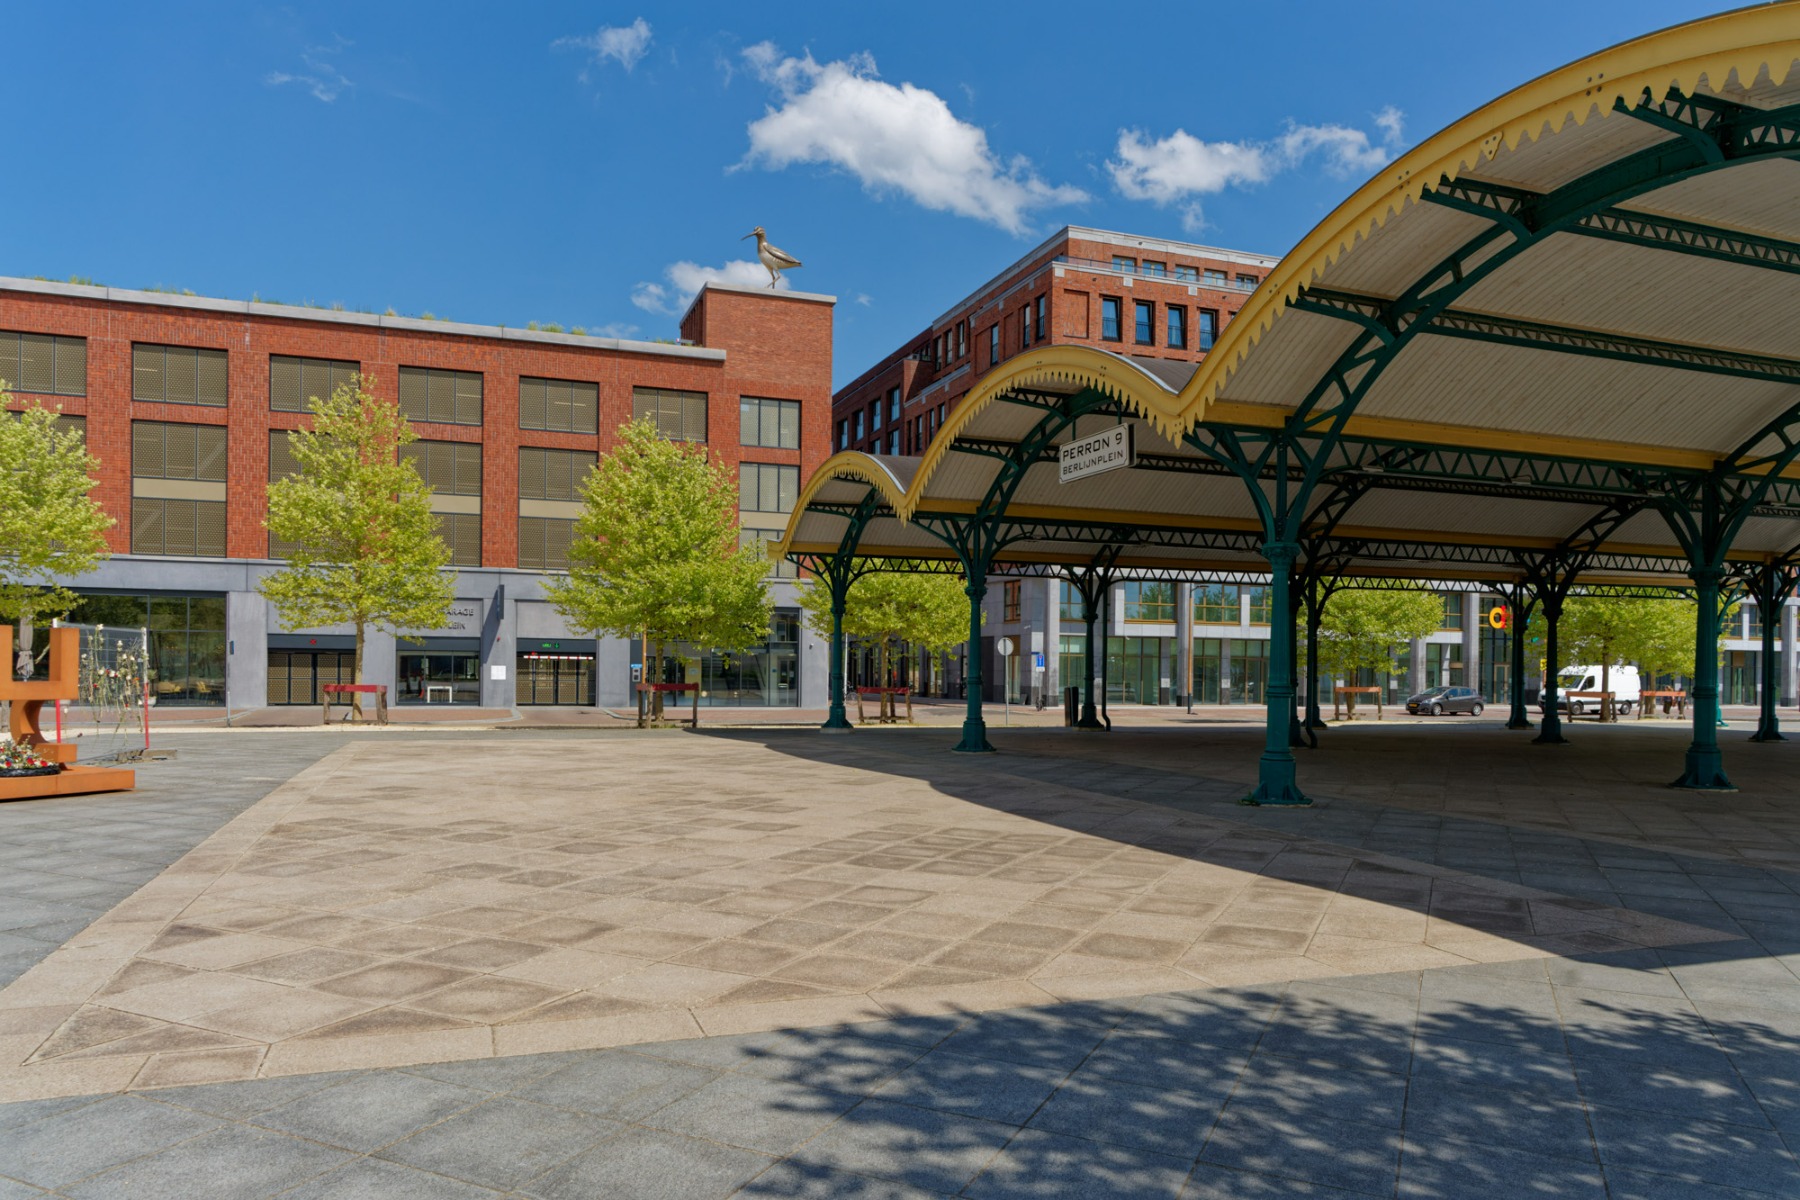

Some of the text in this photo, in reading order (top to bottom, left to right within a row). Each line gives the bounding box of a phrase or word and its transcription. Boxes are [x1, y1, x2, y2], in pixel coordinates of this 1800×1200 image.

[1063, 432, 1122, 462] PERRON 9
[1063, 450, 1123, 475] BERLIJNPLEIN
